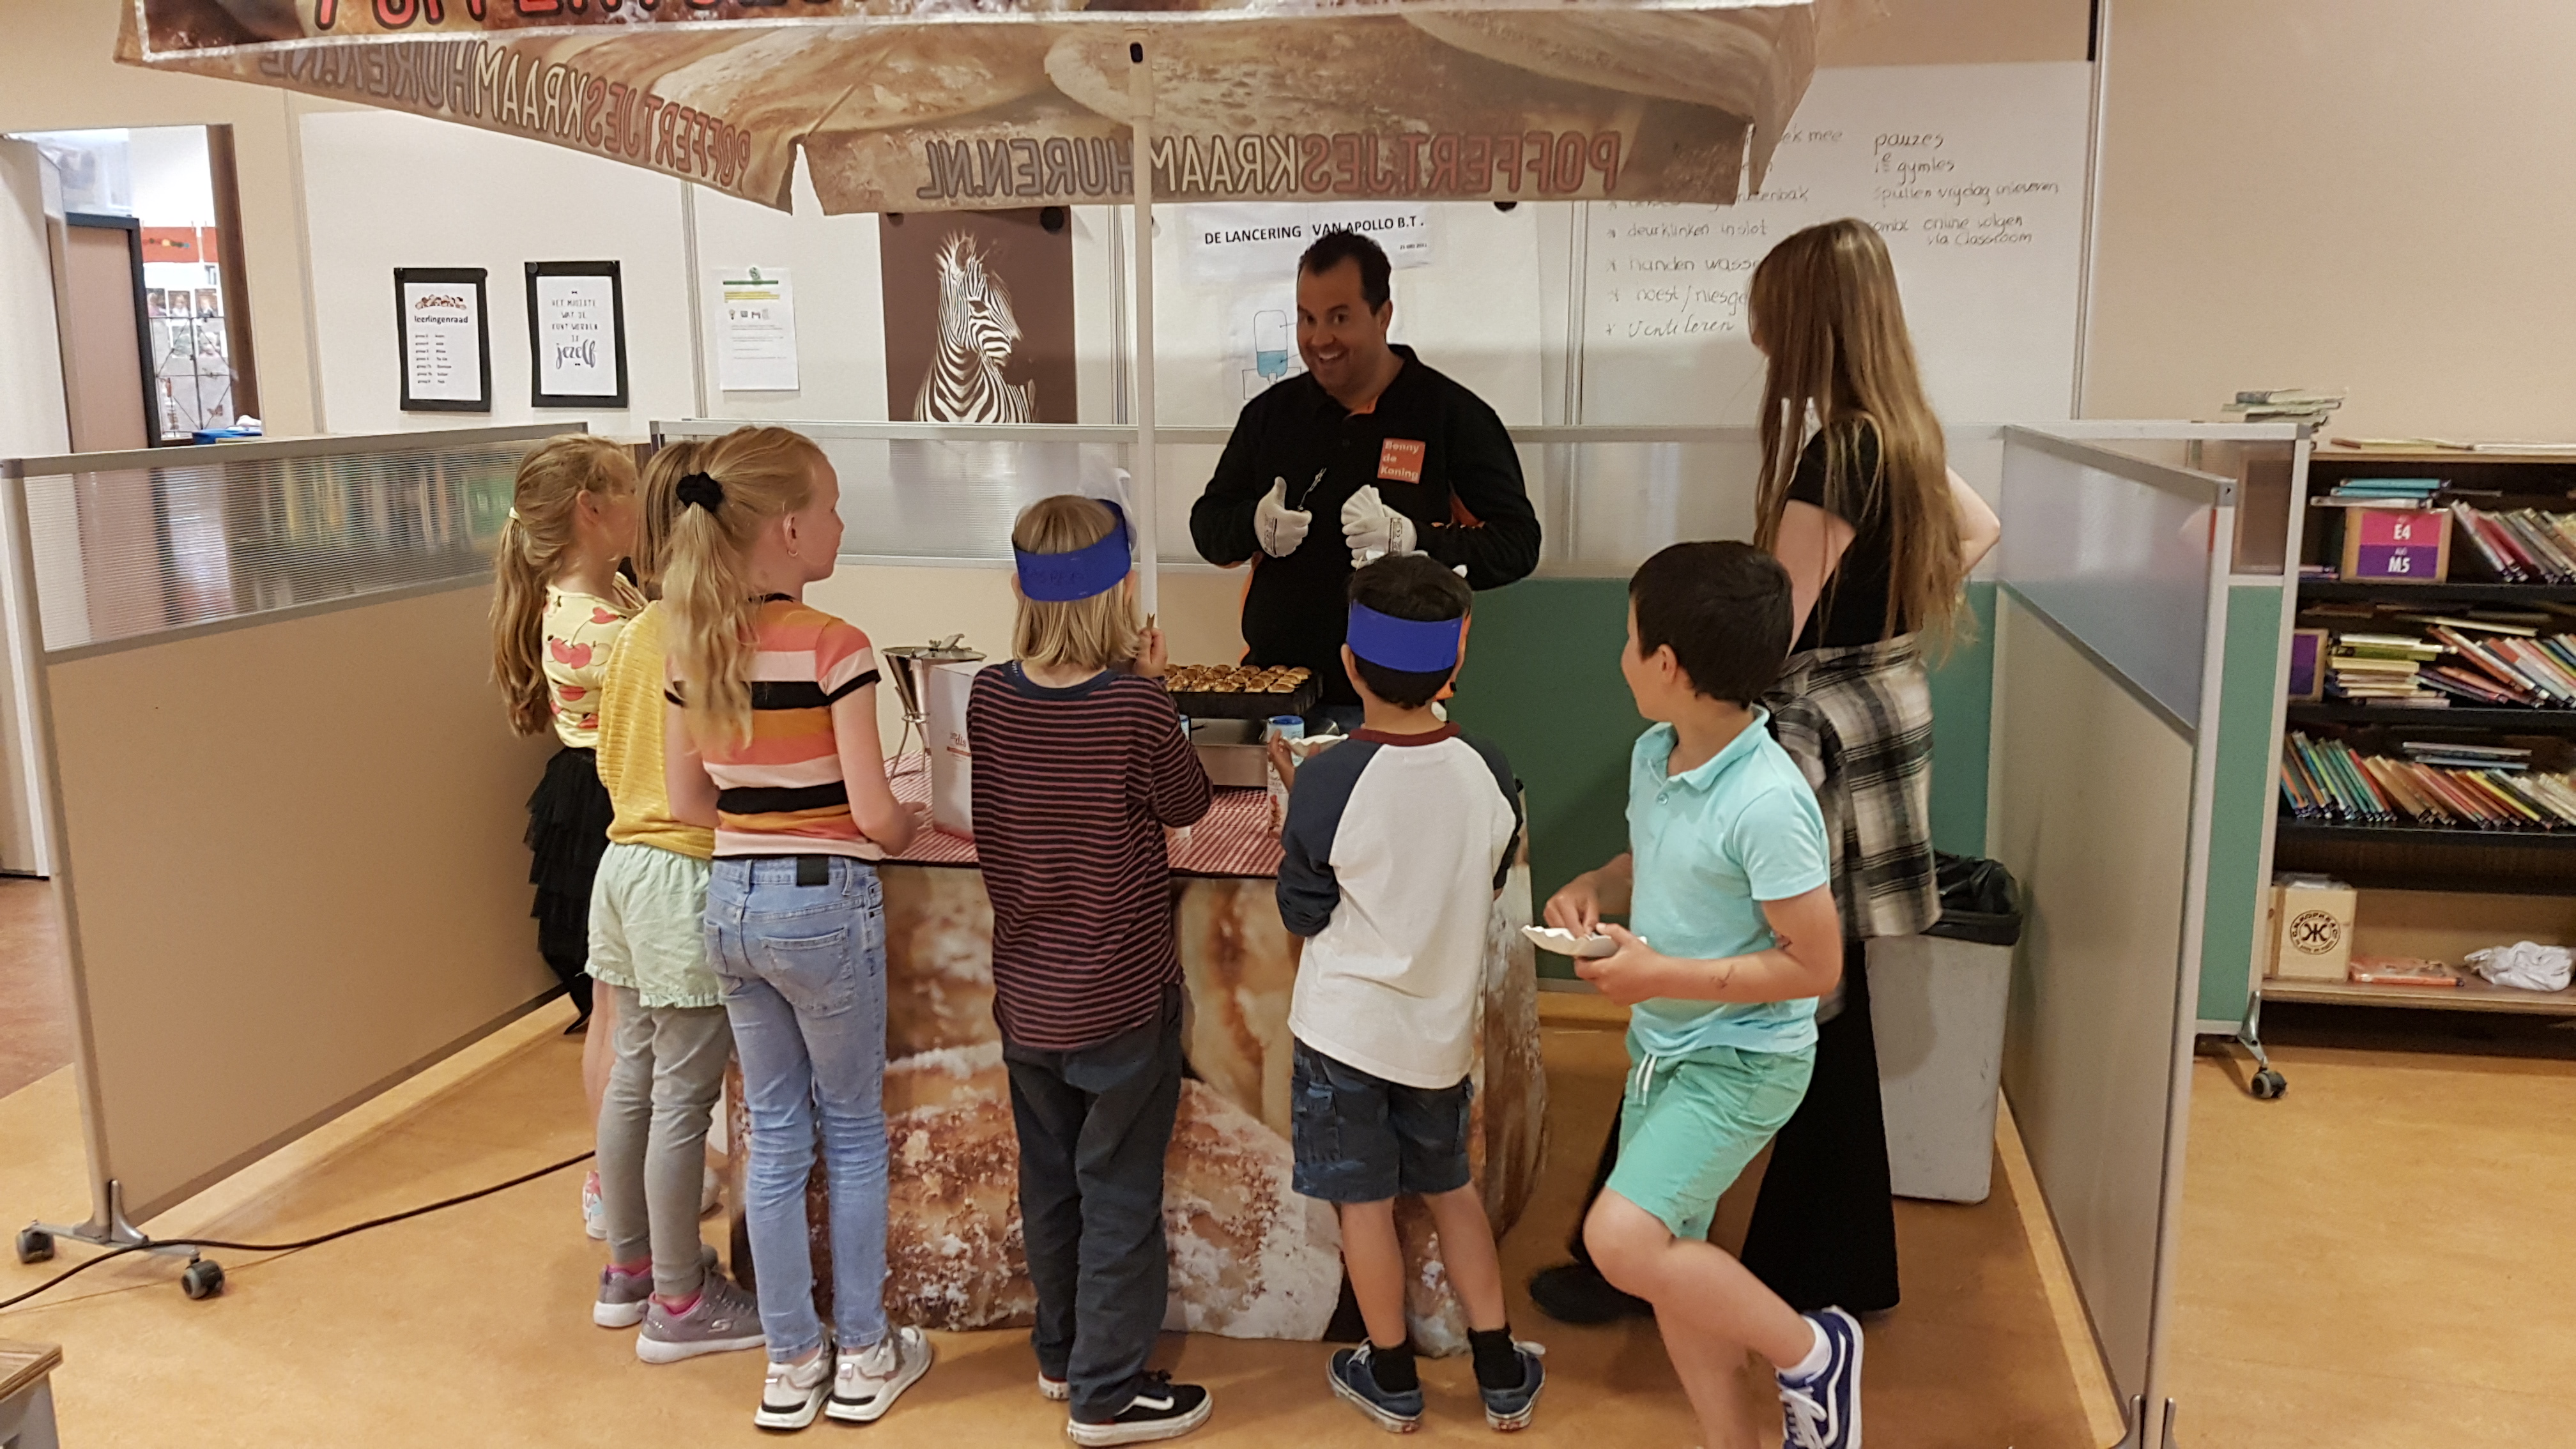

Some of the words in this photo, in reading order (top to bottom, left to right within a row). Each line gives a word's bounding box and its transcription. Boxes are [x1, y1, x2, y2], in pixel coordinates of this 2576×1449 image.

[1874, 133, 1944, 155] pauzes
[1204, 232, 1222, 245] DE
[1225, 226, 1301, 243] LANCERING
[1312, 222, 1341, 236] VAN
[1347, 218, 1393, 234] APOLLO
[414, 315, 469, 325] leerlingenraad
[555, 339, 597, 370] jezelf
[1382, 452, 1397, 463] de
[1380, 465, 1419, 481] Koning
[2393, 523, 2411, 540] E4
[2388, 555, 2411, 573] M5
